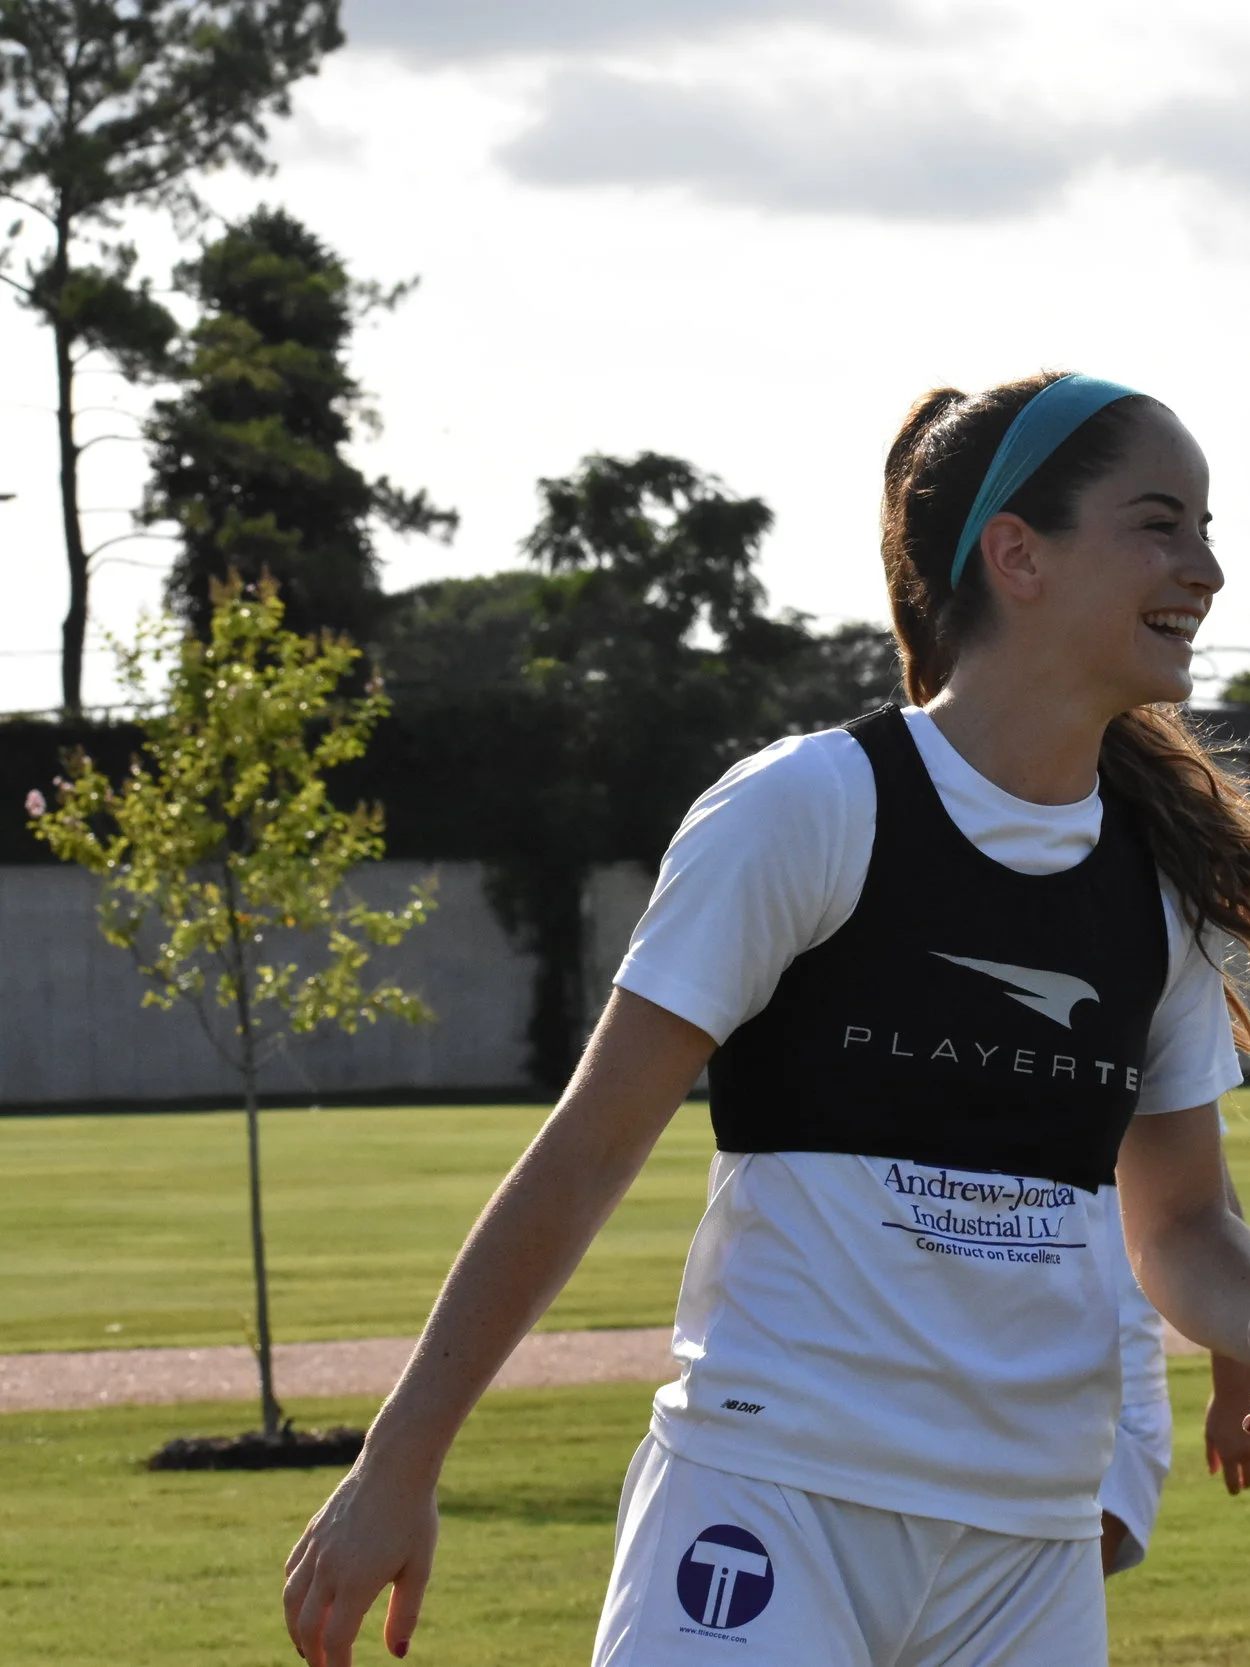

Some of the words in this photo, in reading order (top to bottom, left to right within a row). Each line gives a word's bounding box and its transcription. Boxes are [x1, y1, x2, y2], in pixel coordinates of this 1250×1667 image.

[843, 1025, 1144, 1092] PLAYERTE
[884, 1163, 1076, 1211] Andrew-Jorda
[910, 1204, 1022, 1238] Industrial
